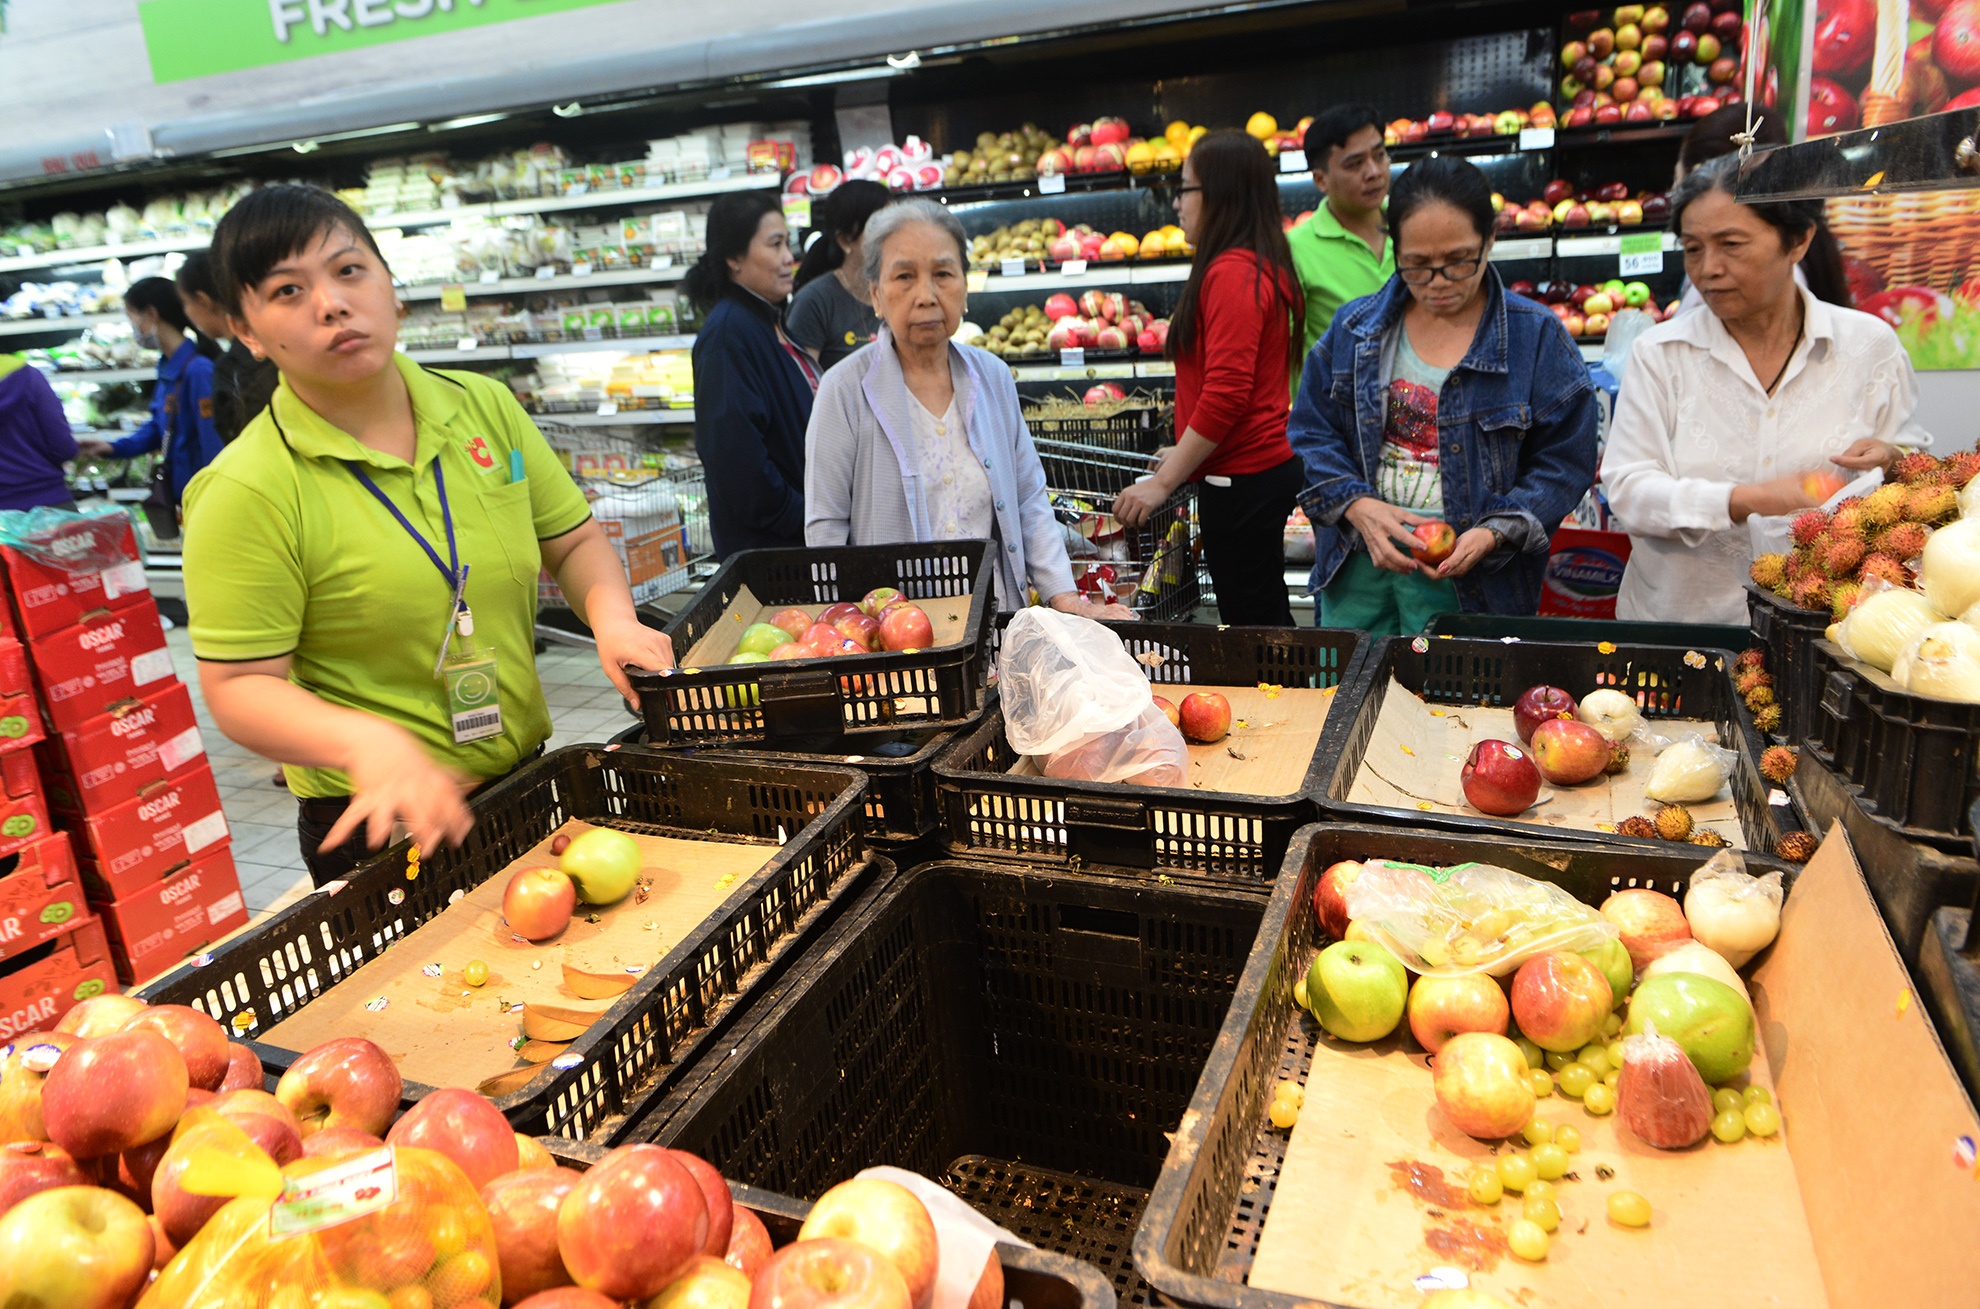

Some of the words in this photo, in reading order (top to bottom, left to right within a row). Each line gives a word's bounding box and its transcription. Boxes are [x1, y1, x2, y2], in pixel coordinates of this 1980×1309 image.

[268, 0, 484, 43] FRE
[51, 531, 97, 557] OSCAR
[79, 622, 125, 650] OSCAR
[110, 708, 156, 737] OSCAR
[137, 791, 182, 821] OSCAR
[160, 874, 202, 905] OSCAR
[0, 996, 58, 1040] SCAR
